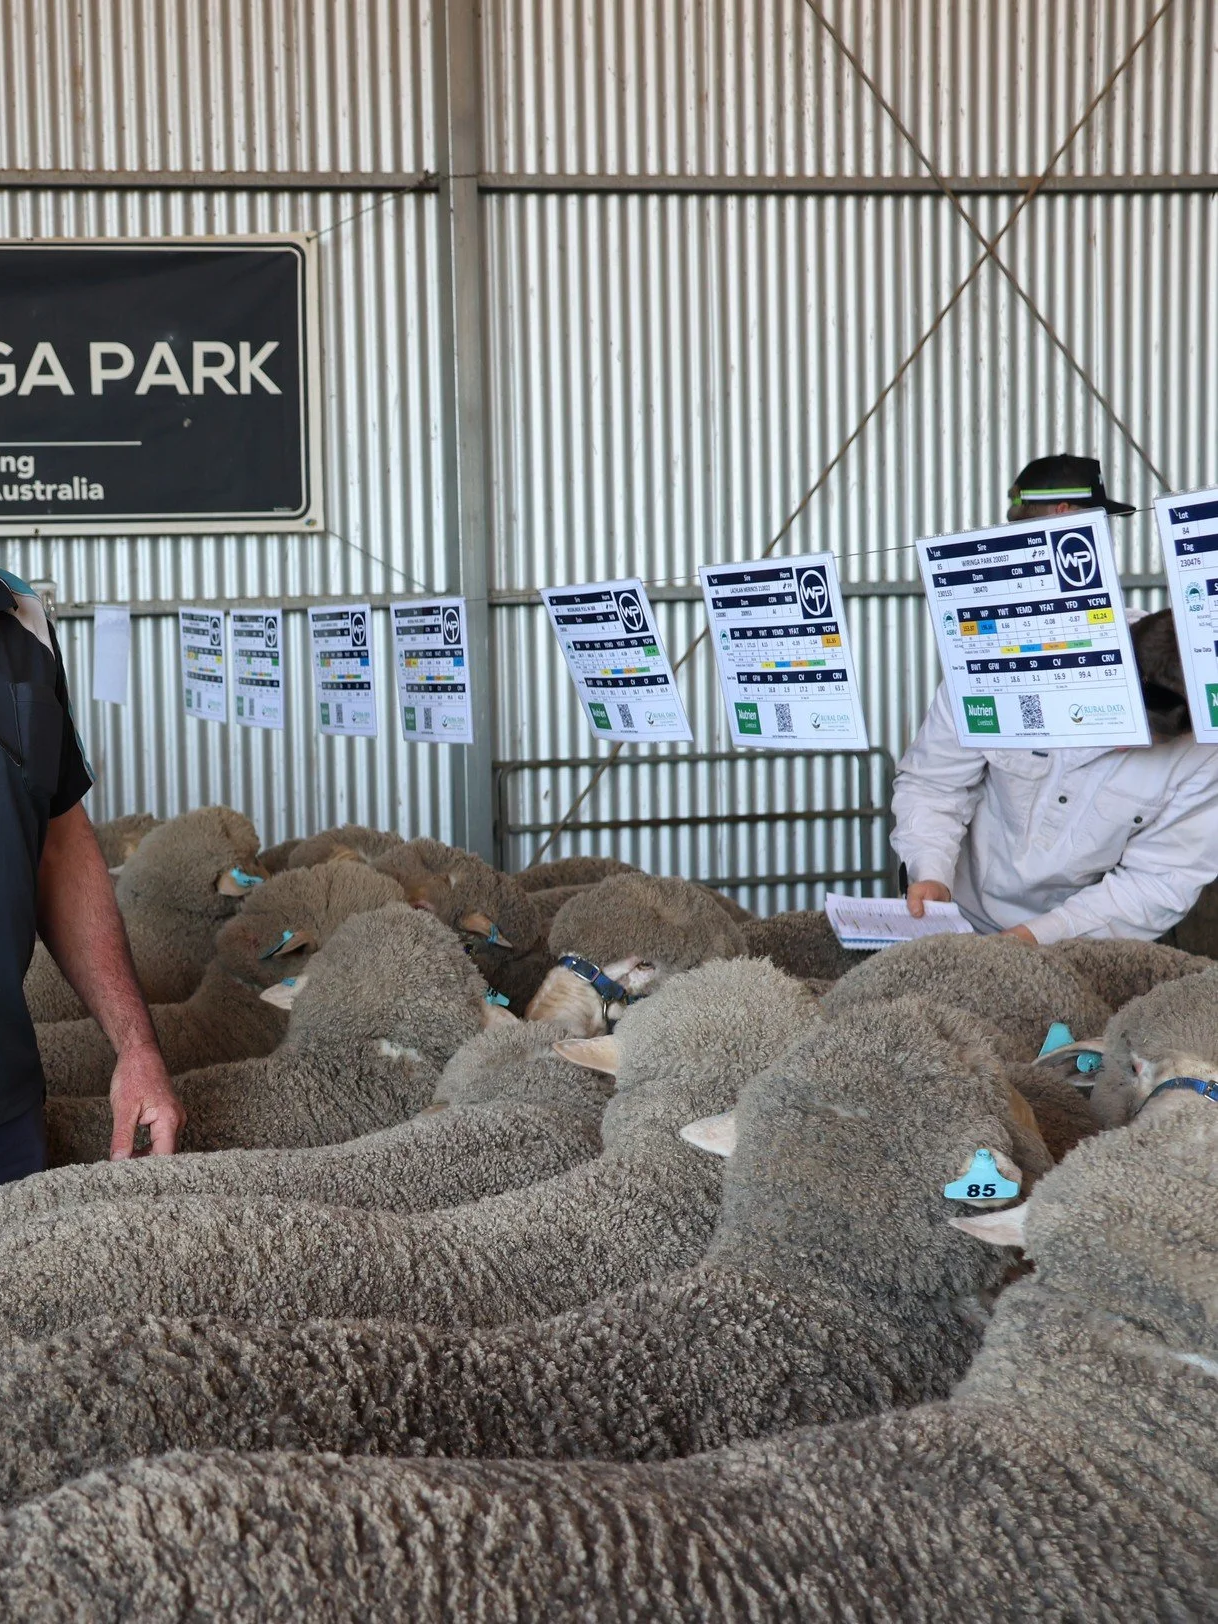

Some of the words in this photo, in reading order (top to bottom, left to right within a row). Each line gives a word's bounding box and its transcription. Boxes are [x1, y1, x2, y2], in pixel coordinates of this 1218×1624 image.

[89, 340, 282, 396] PARK
[1178, 511, 1189, 520] Lot
[1182, 526, 1190, 535] 84
[977, 543, 987, 552] Sire
[1027, 537, 1042, 545] Horn
[1182, 543, 1195, 552] Tag
[962, 558, 980, 567] WIRINGA
[1180, 558, 1202, 568] 230476
[938, 577, 947, 585] Tag
[972, 573, 983, 581] Dam
[1034, 565, 1046, 574] NIB
[963, 611, 971, 619] SM
[997, 608, 1009, 616] YWT
[1015, 606, 1033, 614] YEMD
[1039, 603, 1054, 612] YFAT
[1065, 601, 1078, 609] YFD
[1087, 597, 1106, 606] YCFW
[806, 626, 815, 634] YFD
[822, 625, 836, 633] YCFW
[970, 663, 981, 671] BWT
[1029, 660, 1038, 668] SD
[1053, 658, 1061, 666] CV
[1078, 656, 1086, 664] CF
[1101, 653, 1115, 662] CRV
[832, 672, 843, 680] CRV
[738, 709, 757, 720] Nutrien
[967, 704, 993, 716] Nutrien
[1084, 705, 1106, 714] RURAL
[1107, 704, 1125, 712] DATA
[966, 1183, 996, 1197] 85
